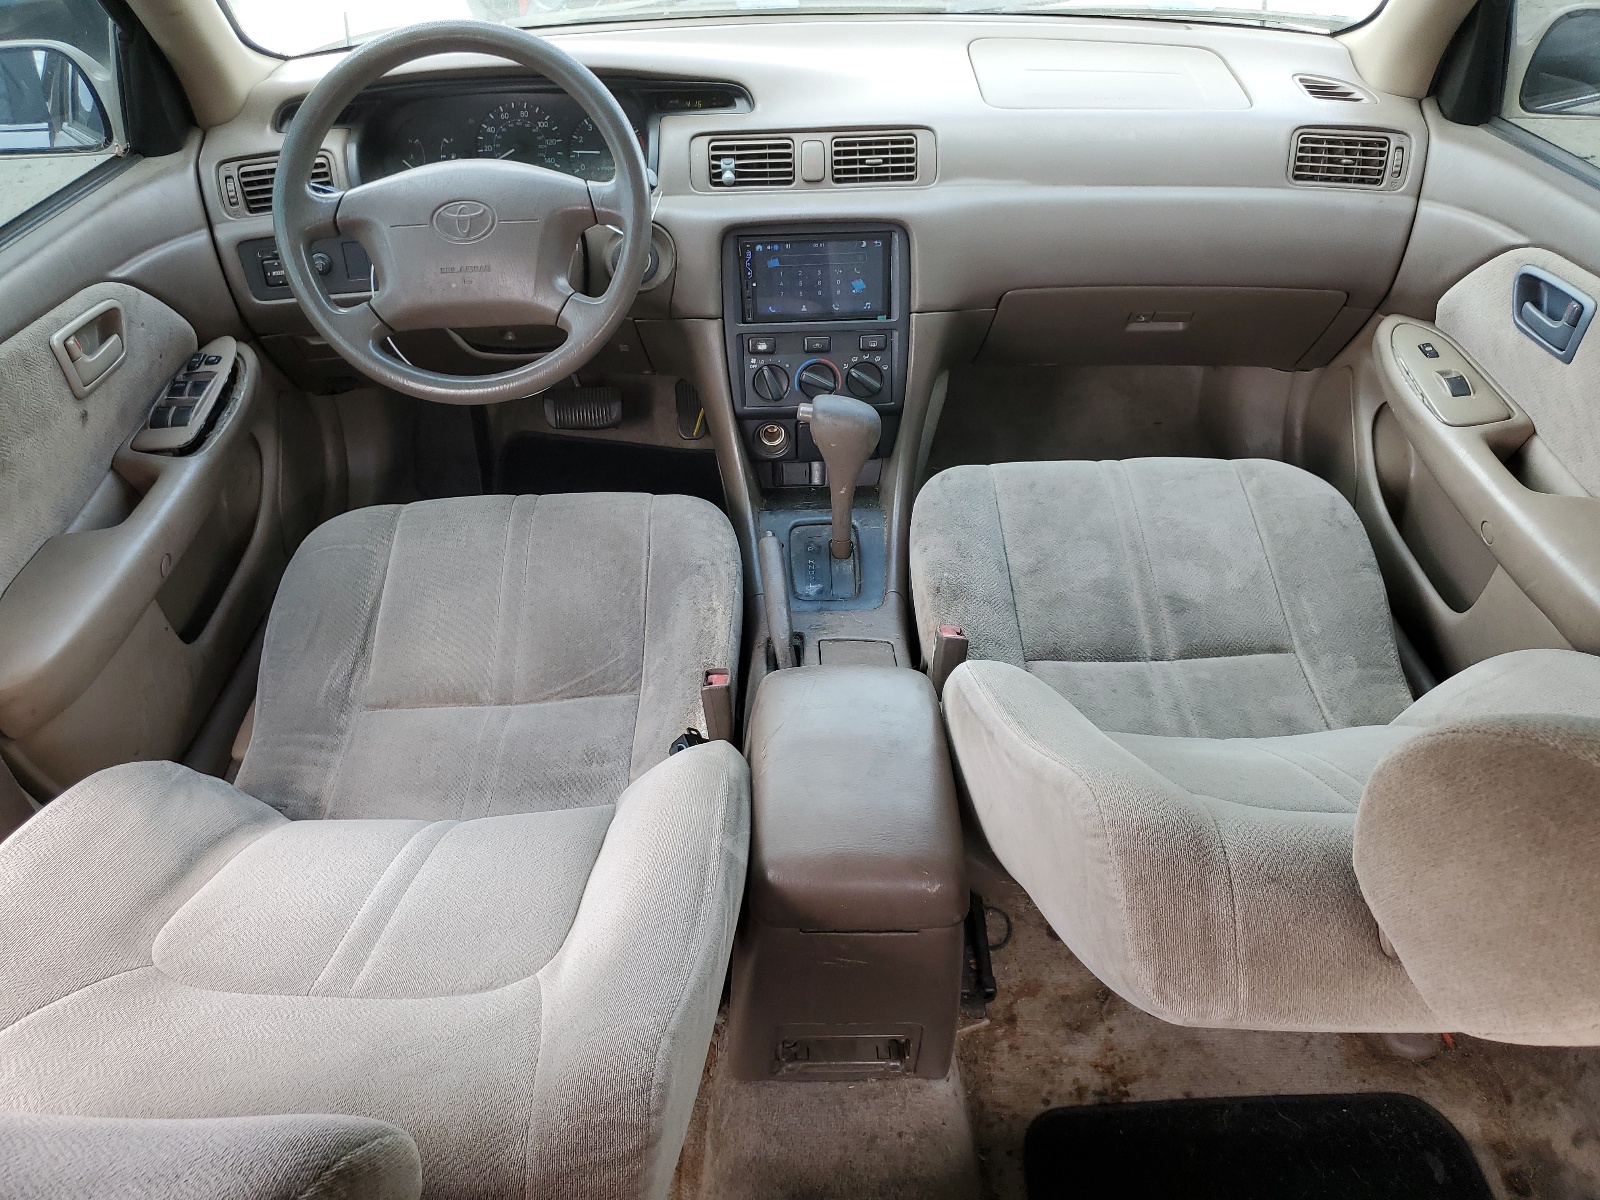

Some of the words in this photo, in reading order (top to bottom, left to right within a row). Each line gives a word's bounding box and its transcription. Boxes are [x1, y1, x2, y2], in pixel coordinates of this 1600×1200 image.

[587, 124, 593, 132] 3
[578, 135, 584, 143] 2
[580, 163, 586, 171] 0
